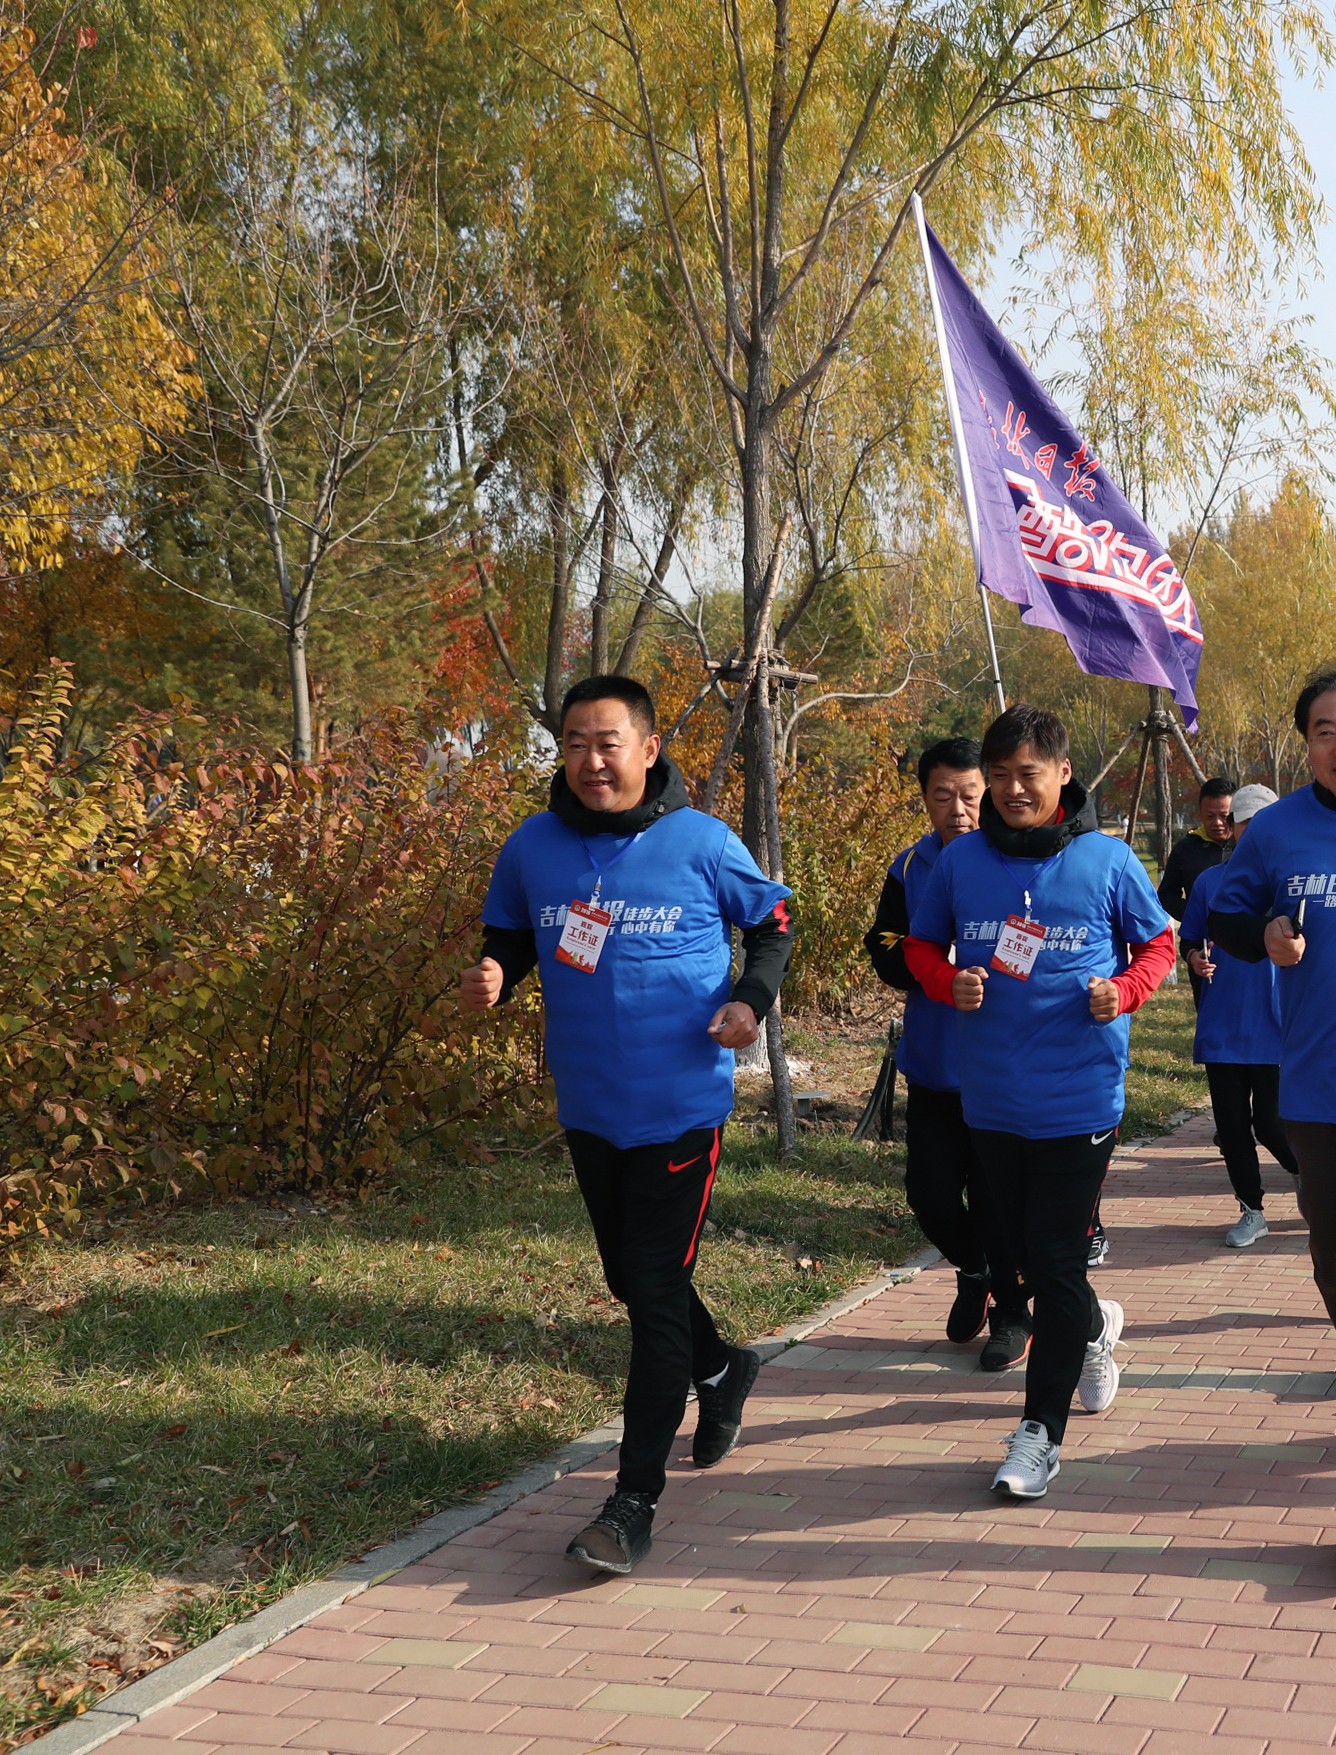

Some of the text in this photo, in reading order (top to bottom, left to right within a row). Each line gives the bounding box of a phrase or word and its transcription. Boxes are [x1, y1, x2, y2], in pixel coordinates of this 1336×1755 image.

[567, 925, 599, 947] 工作证
[621, 921, 677, 935] 心中有你
[1003, 937, 1034, 957] 工作证
